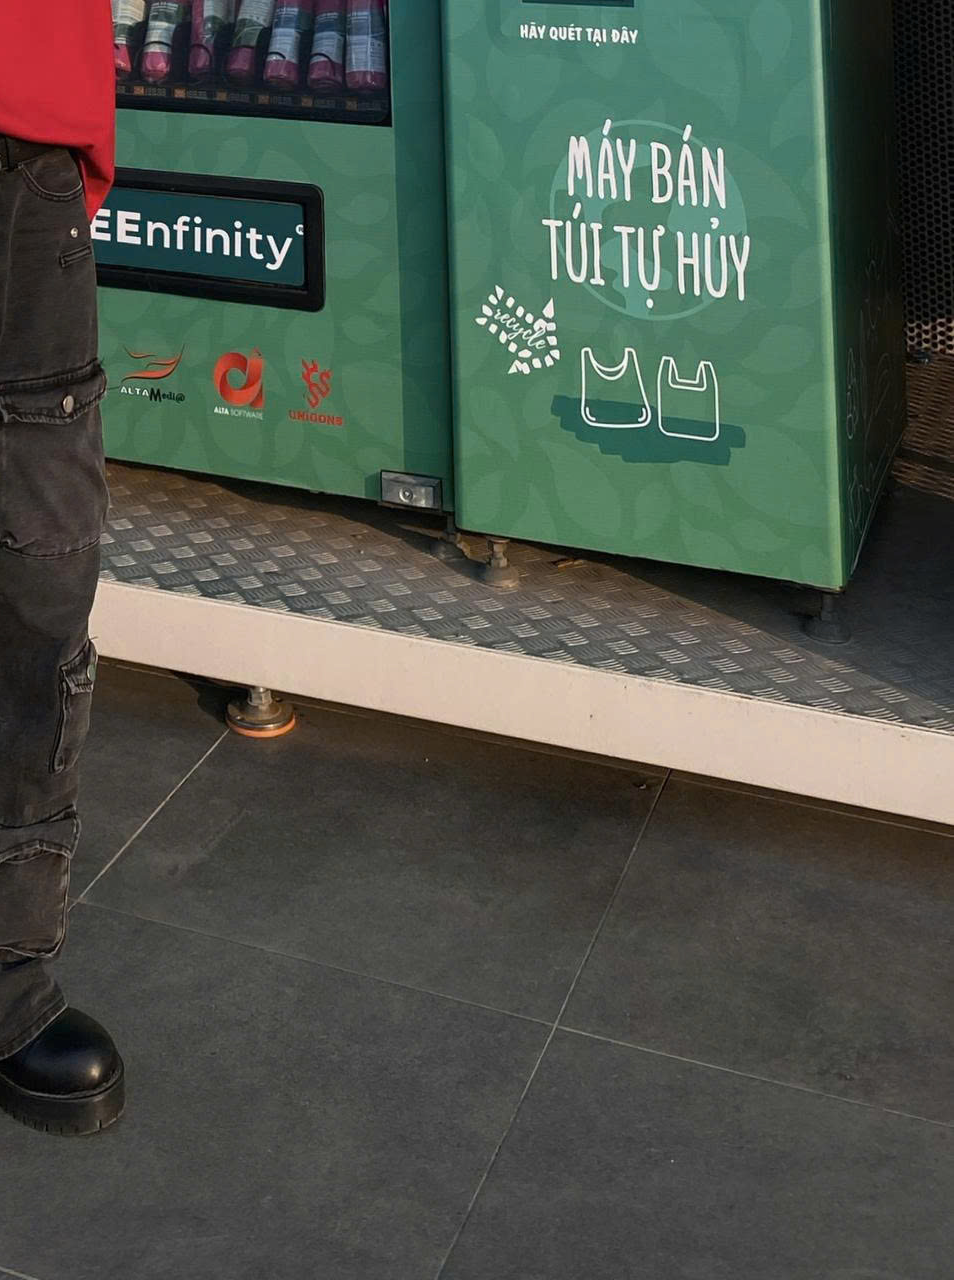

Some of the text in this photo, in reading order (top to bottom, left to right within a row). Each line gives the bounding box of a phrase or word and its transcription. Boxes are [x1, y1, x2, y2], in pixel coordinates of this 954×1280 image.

[520, 21, 639, 47] HÃY QUÉT TẠI ĐÂY
[567, 118, 727, 209] MÁY BÁN
[542, 202, 751, 309] TÚI TỰ HỦY
[493, 305, 548, 351] recycle
[213, 405, 230, 416] ALTA
